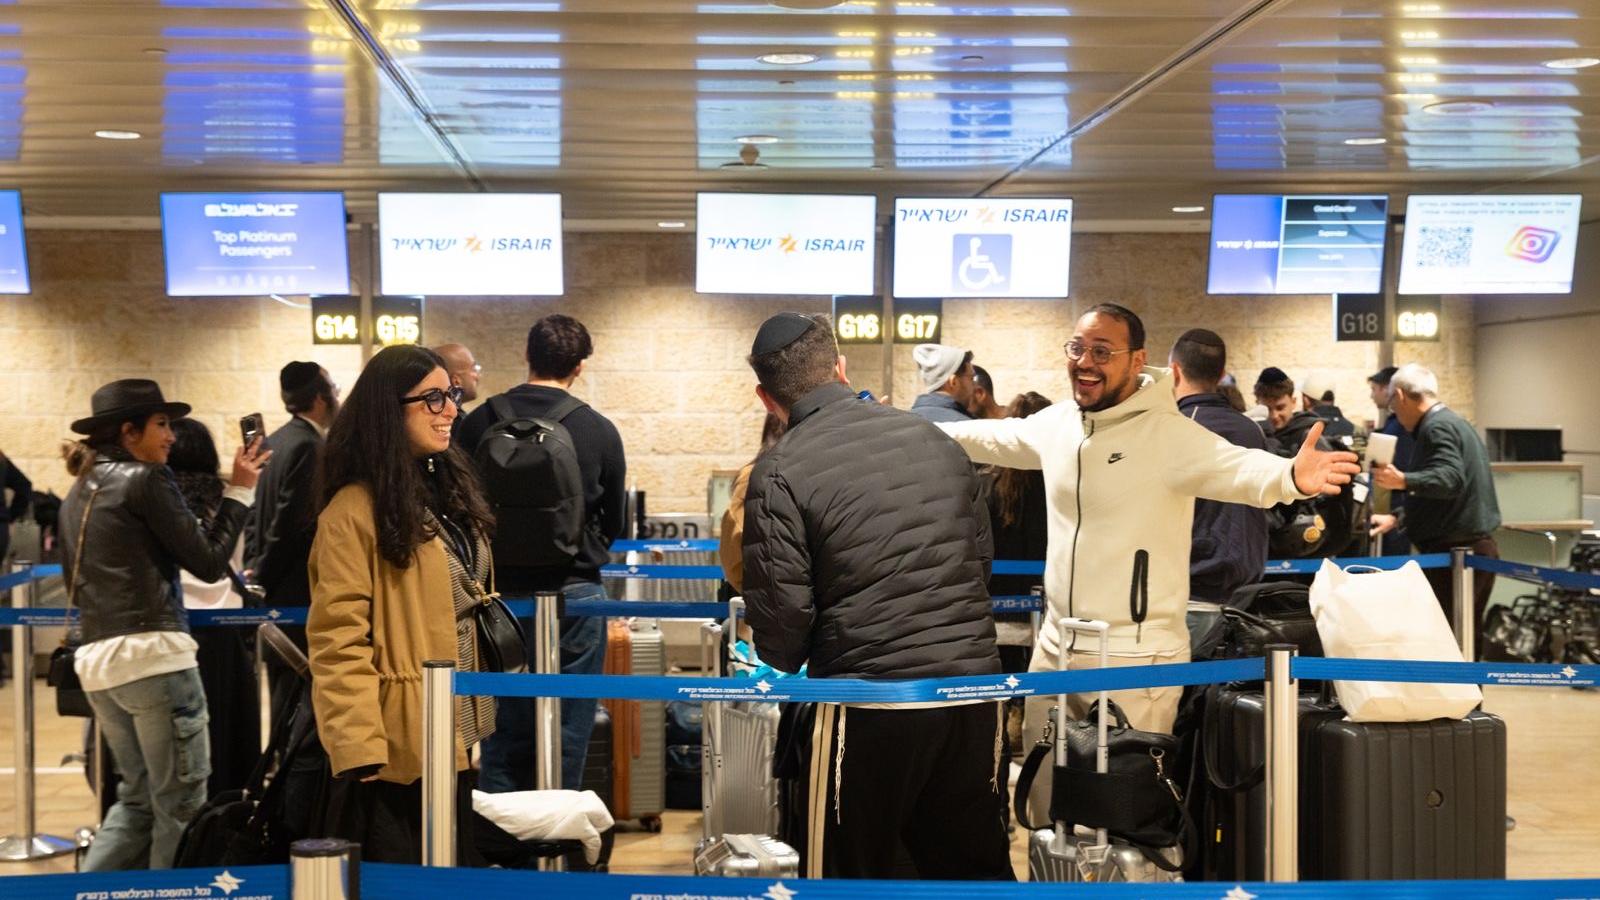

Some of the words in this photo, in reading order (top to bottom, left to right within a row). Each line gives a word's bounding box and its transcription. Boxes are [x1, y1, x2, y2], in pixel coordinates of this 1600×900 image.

[899, 208, 968, 222] ישראייר
[1003, 208, 1069, 222] ISRAIR
[212, 230, 237, 244] Top
[239, 230, 297, 242] Platinum
[392, 237, 457, 251] ישראייר
[491, 237, 552, 251] ISRAIR
[707, 237, 772, 251] ישראייר
[220, 245, 292, 258] Passengers
[805, 238, 865, 251] ISRAIR
[315, 314, 358, 340] G14
[377, 314, 420, 341] G15
[839, 313, 880, 339] G16
[898, 313, 939, 339] G17
[1342, 312, 1379, 334] G18
